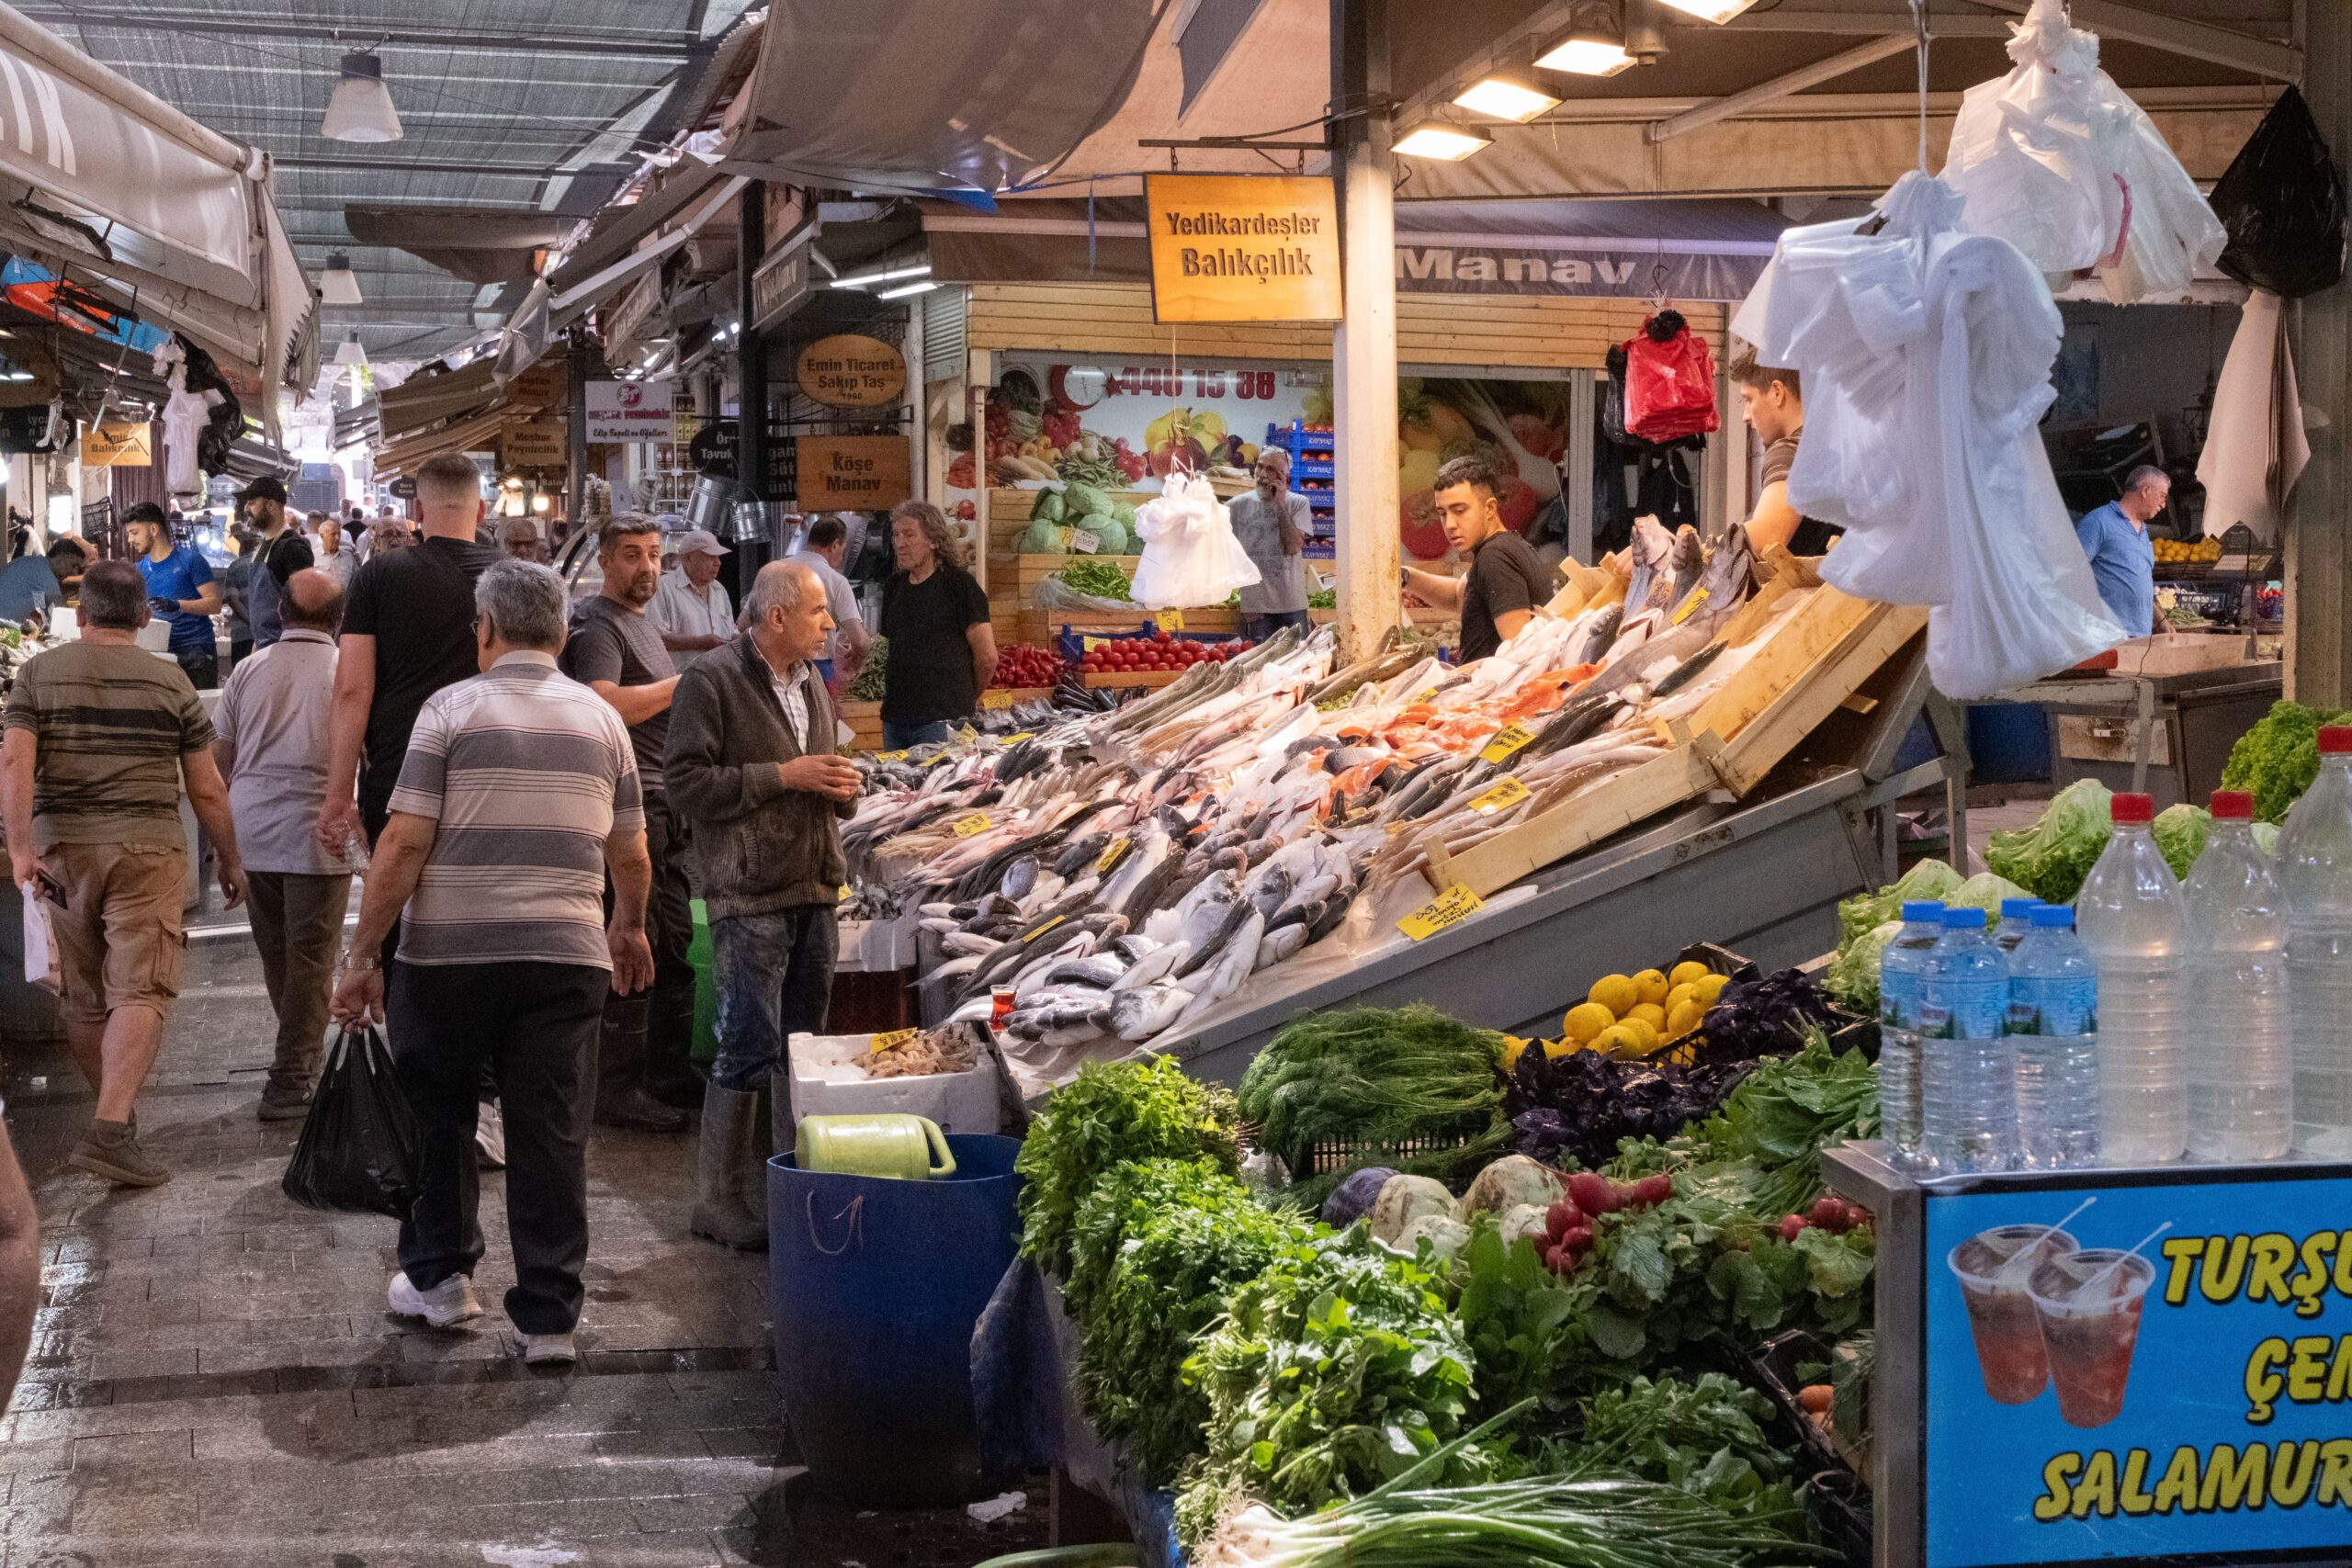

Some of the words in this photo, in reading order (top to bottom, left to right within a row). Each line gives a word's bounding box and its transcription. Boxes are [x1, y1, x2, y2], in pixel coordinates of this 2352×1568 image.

[1165, 211, 1320, 242] Yedikardeşler
[1181, 247, 1313, 285] Balıkçılık
[1395, 248, 1637, 284] Manav
[807, 359, 842, 372] Emin
[846, 358, 897, 372] Ticaret
[861, 376, 886, 392] Taş
[1193, 369, 1225, 399] 15
[1237, 371, 1275, 400] 88
[831, 455, 874, 476] Köşe
[826, 476, 882, 491] Manav
[2032, 1438, 2352, 1523] SALAMUR
